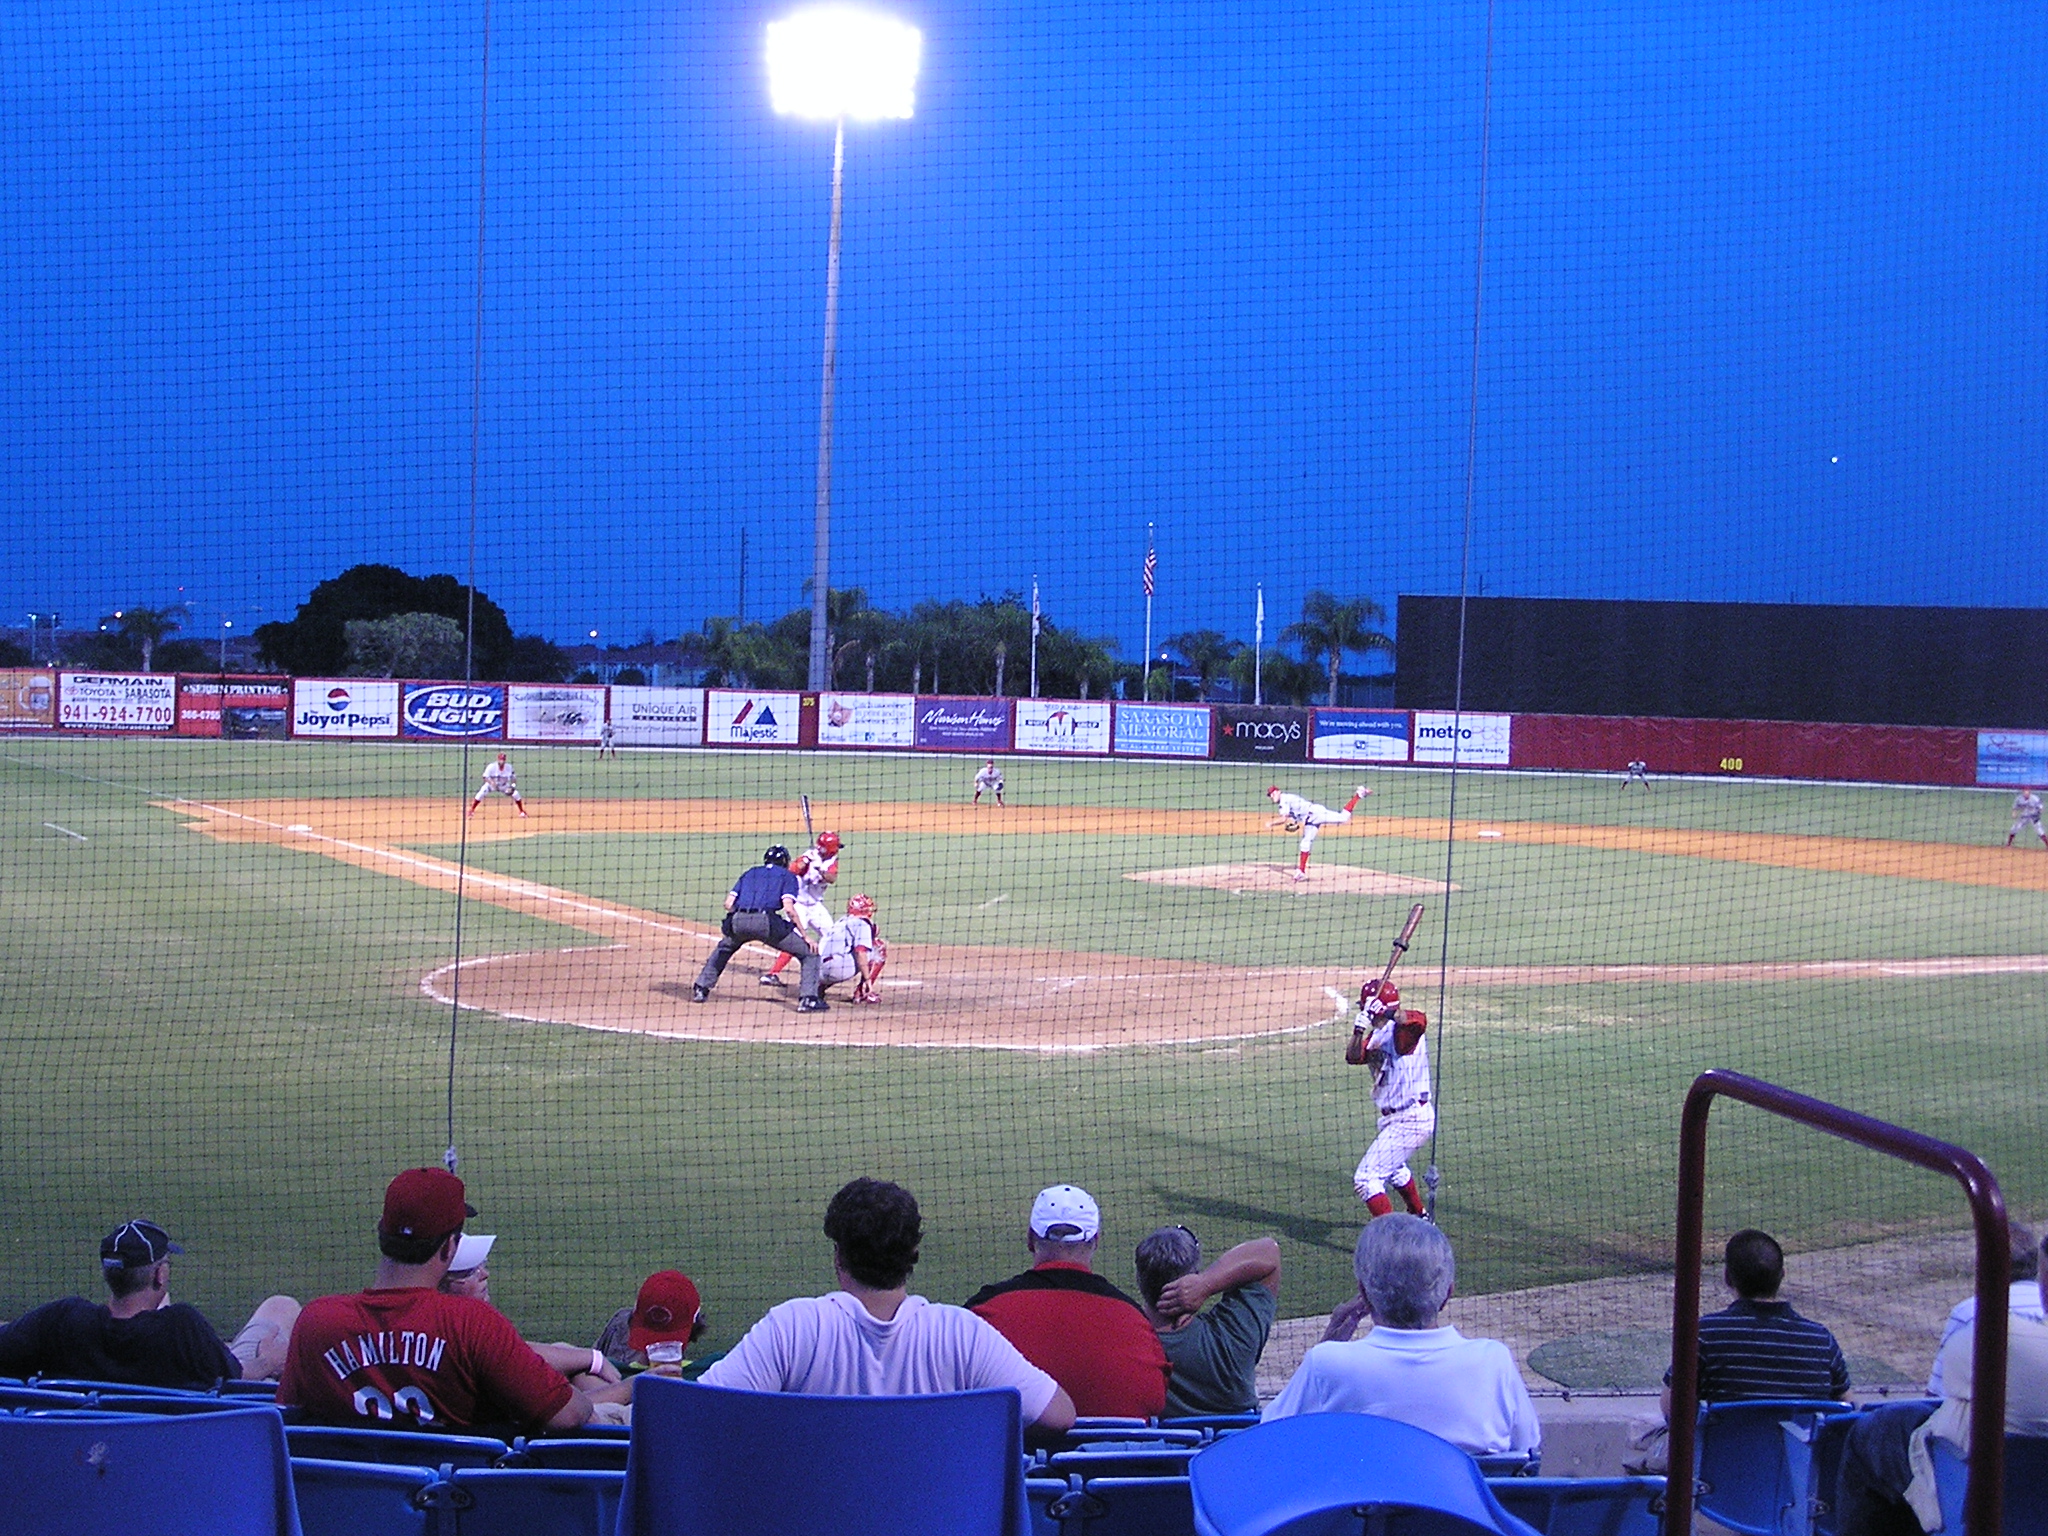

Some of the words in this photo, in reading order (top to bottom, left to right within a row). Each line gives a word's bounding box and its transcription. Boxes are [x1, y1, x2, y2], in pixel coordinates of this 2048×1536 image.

[73, 676, 163, 686] GERMAIN
[80, 687, 116, 696] TOYOTA
[125, 687, 172, 699] SARASOTA
[229, 685, 281, 695] PRINTING
[426, 692, 492, 708] BUD
[63, 704, 172, 722] 941-924-7700
[413, 708, 502, 724] LIGHT
[632, 704, 674, 714] UNIQUE
[678, 705, 697, 715] AIR
[297, 712, 329, 728] Joy
[330, 713, 345, 724] of
[348, 713, 390, 727] Pepsi
[1120, 710, 1203, 727] SARASOTA
[731, 725, 778, 740] Majestic
[1120, 723, 1203, 739] MEMORIAL
[1720, 757, 1743, 770] 400
[324, 1331, 447, 1380] HAMILTON
